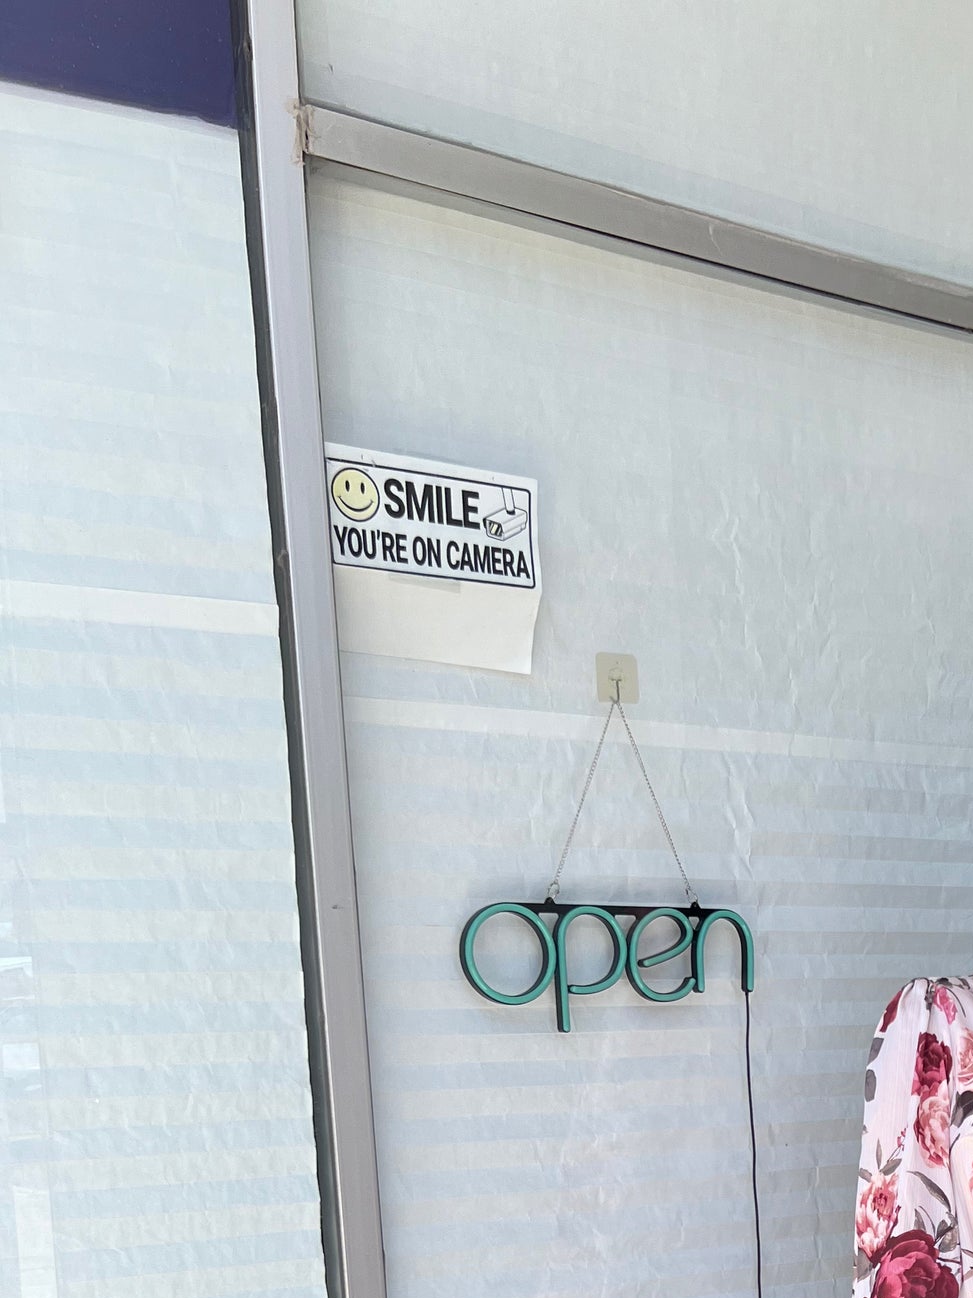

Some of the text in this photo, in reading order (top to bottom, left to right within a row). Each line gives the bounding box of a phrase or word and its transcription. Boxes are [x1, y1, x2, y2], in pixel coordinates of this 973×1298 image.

[384, 478, 481, 530] SMILE
[333, 524, 531, 580] YOU'RE ON CAMERA
[459, 902, 755, 1033] open
